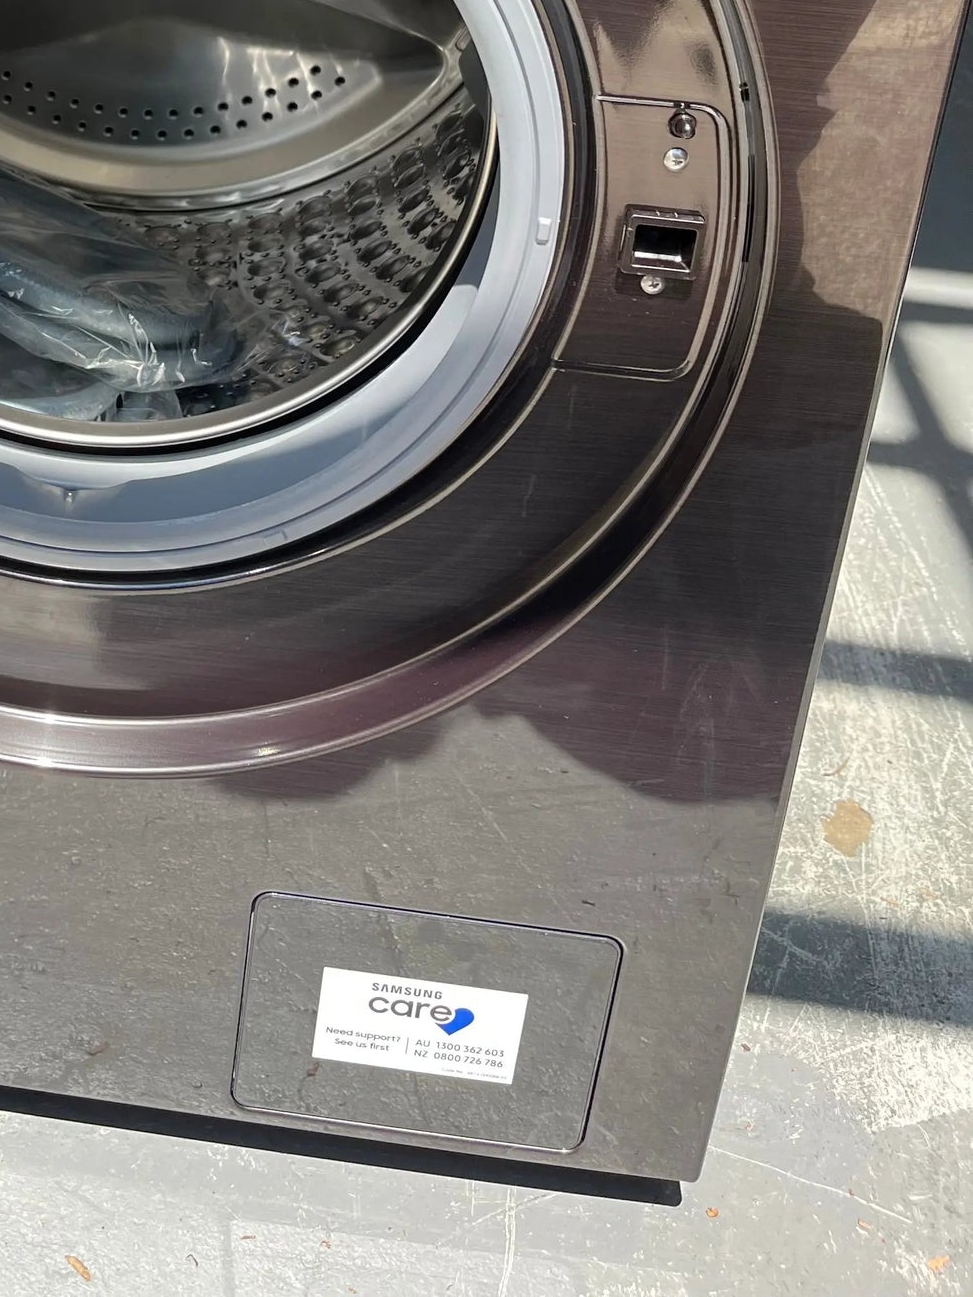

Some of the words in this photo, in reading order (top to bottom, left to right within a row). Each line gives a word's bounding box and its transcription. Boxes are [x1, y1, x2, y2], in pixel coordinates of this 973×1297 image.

[372, 982, 443, 1000] SAMSUNG
[368, 996, 452, 1022] care
[326, 1026, 353, 1036] Need
[355, 1031, 401, 1043] support?
[334, 1037, 354, 1047] See
[355, 1041, 368, 1049] us
[369, 1042, 389, 1051] first
[415, 1038, 431, 1048] AU
[436, 1041, 461, 1052] 1300
[463, 1045, 483, 1055] 362
[484, 1048, 505, 1057] 603
[414, 1049, 429, 1058] NZ
[433, 1052, 461, 1063] 0800
[463, 1055, 482, 1065] 726
[484, 1058, 504, 1068] 786
